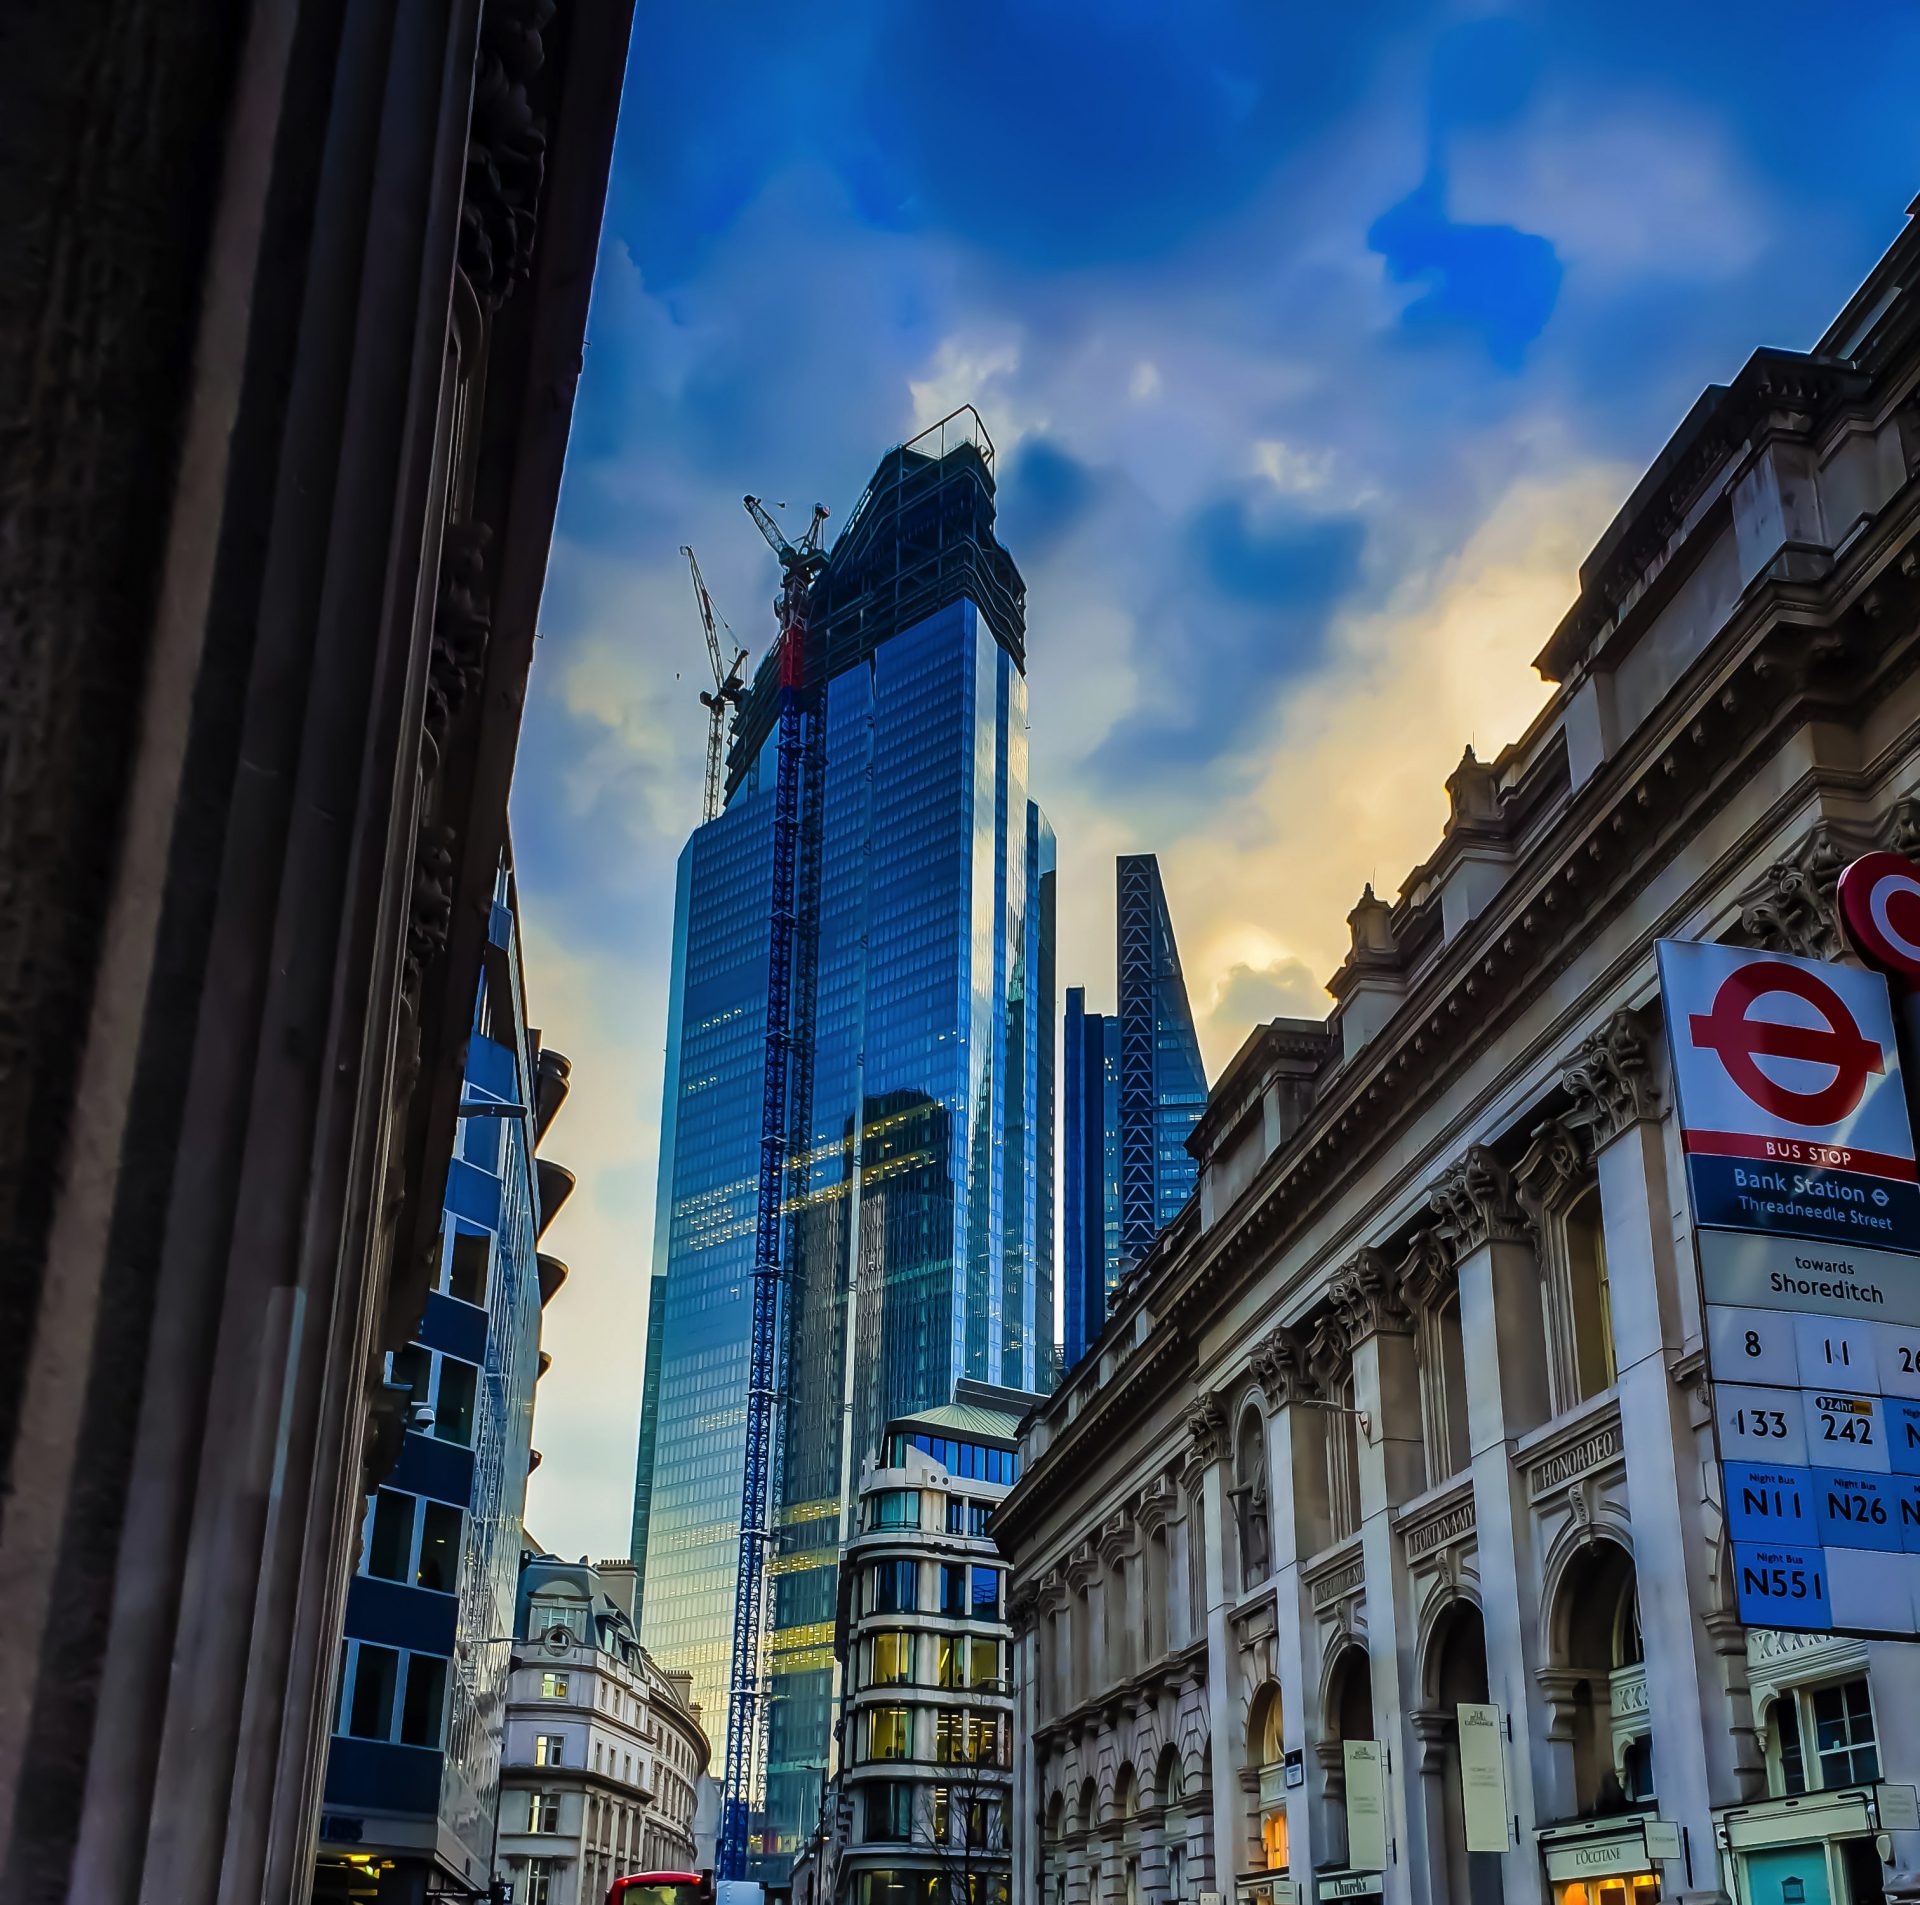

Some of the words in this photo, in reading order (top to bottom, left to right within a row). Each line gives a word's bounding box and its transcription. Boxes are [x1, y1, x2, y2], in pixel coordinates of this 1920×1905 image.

[1765, 1141, 1801, 1159] BUS
[1809, 1147, 1851, 1166] STOP
[1734, 1168, 1787, 1192] Bank
[1794, 1175, 1865, 1203] Station
[1738, 1195, 1846, 1222] Threadneedle
[1850, 1210, 1893, 1231] Street
[1795, 1256, 1855, 1275] towards
[1770, 1272, 1884, 1304] Shoreditch
[1745, 1330, 1762, 1357] 8
[1824, 1338, 1850, 1366] 11
[1828, 1398, 1853, 1412] 24hr
[1737, 1408, 1788, 1439] 133
[1820, 1414, 1873, 1445] 242
[1749, 1473, 1775, 1485] Night
[1778, 1475, 1796, 1485] Bus
[1833, 1478, 1858, 1490] Night
[1860, 1480, 1876, 1491] Bus
[1743, 1487, 1801, 1519] N11
[1827, 1492, 1887, 1525] N26
[1756, 1552, 1784, 1565] Night
[1785, 1554, 1804, 1565] Bus
[1743, 1567, 1822, 1600] N551
